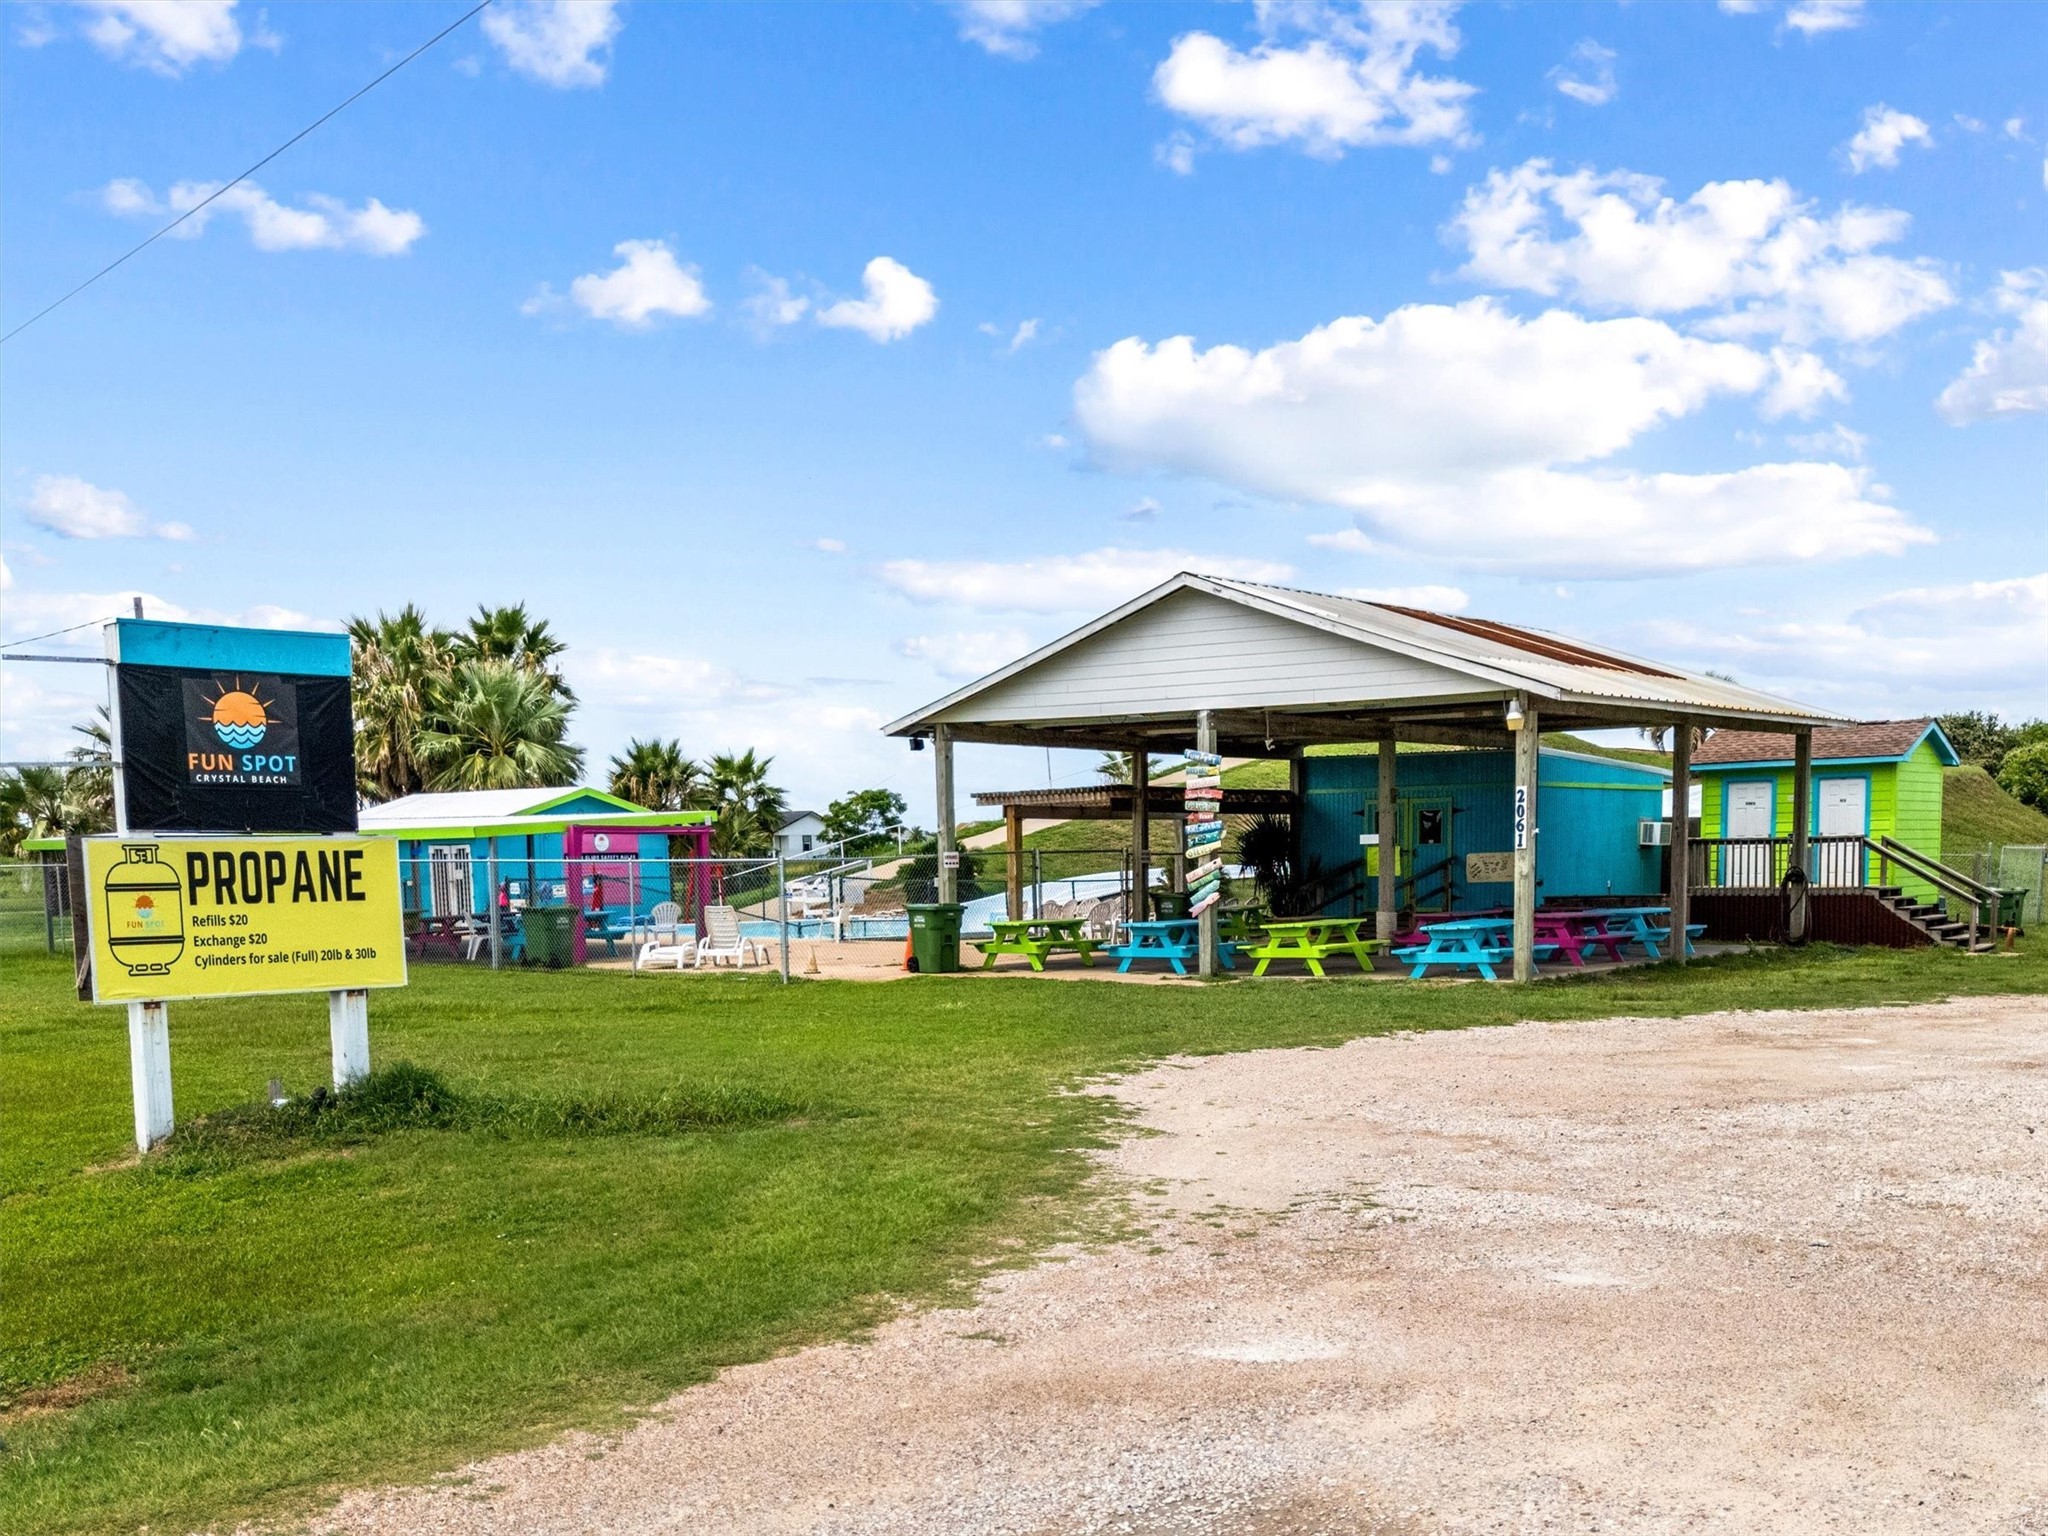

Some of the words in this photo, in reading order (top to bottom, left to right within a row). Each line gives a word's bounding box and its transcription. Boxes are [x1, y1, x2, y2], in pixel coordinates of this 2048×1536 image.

[188, 753, 234, 771] FUN
[242, 754, 296, 772] SPOT
[195, 774, 246, 783] CRYSTAL
[251, 775, 287, 784] BEACH
[1516, 789, 1525, 847] 2061
[186, 850, 366, 905] PROPANE
[126, 920, 144, 929] FUN
[144, 920, 166, 929] SPOT
[192, 914, 227, 927] Refills
[229, 914, 248, 927] $20
[193, 934, 246, 949] Exchange
[248, 933, 268, 945] $20
[195, 954, 247, 969] Cylinders
[249, 952, 264, 964] for
[267, 951, 289, 963] sale
[291, 949, 319, 964] (Full)
[320, 949, 343, 961] 20lb
[345, 948, 353, 960] &
[355, 947, 377, 960] 30lb
